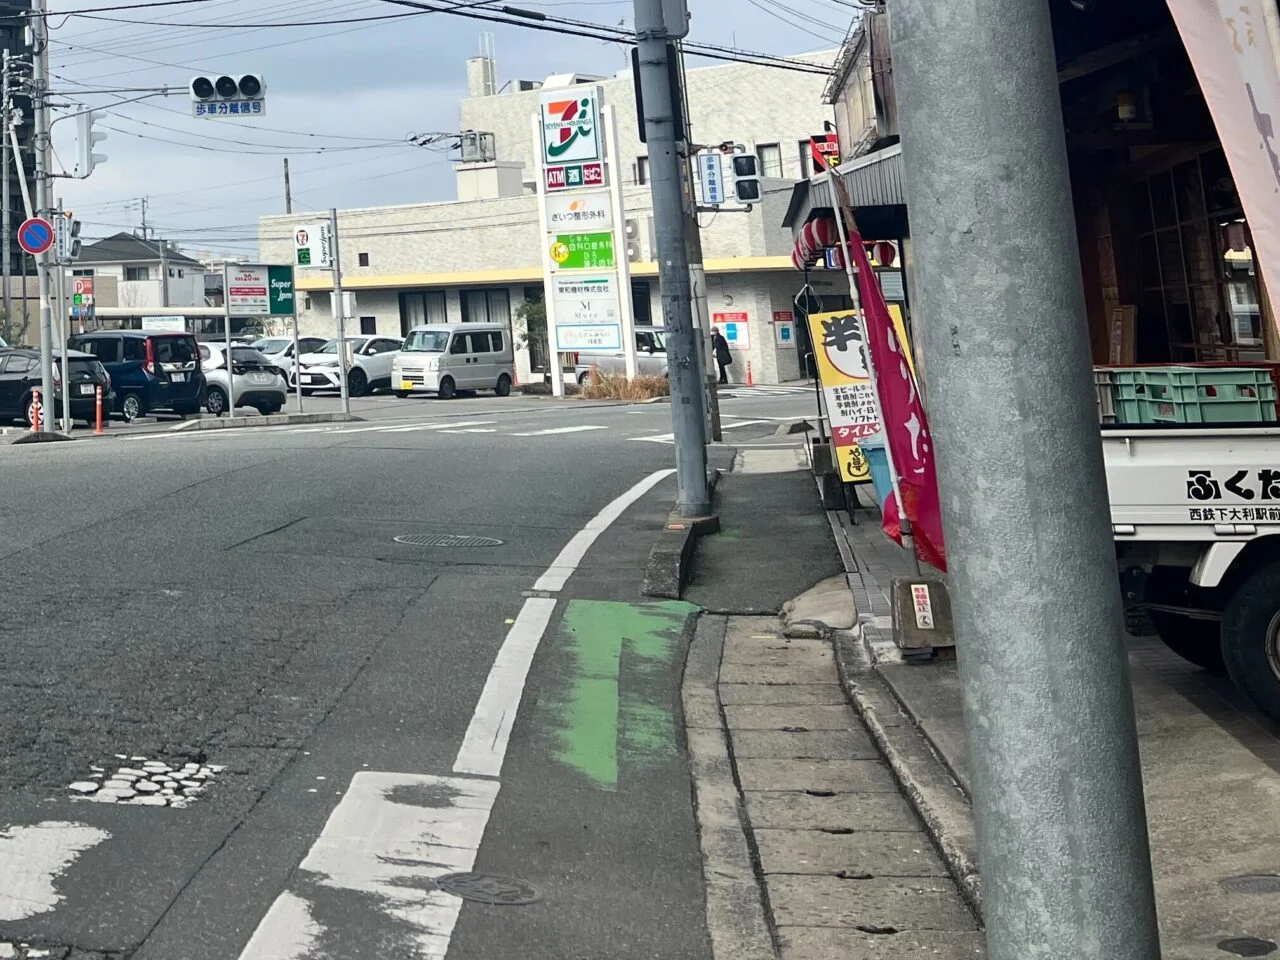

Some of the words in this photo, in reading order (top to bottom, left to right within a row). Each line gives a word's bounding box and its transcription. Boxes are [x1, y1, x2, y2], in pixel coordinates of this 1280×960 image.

[196, 101, 262, 116] 歩車分離信号
[548, 170, 564, 185] ATM
[567, 169, 580, 183] 酒
[551, 210, 605, 222] ざいつ整形外科
[271, 278, 292, 289] Super
[278, 290, 293, 301] jpm
[840, 407, 877, 417] 酎ハイ・日
[1188, 507, 1280, 521] 西鉄下大利駅前
